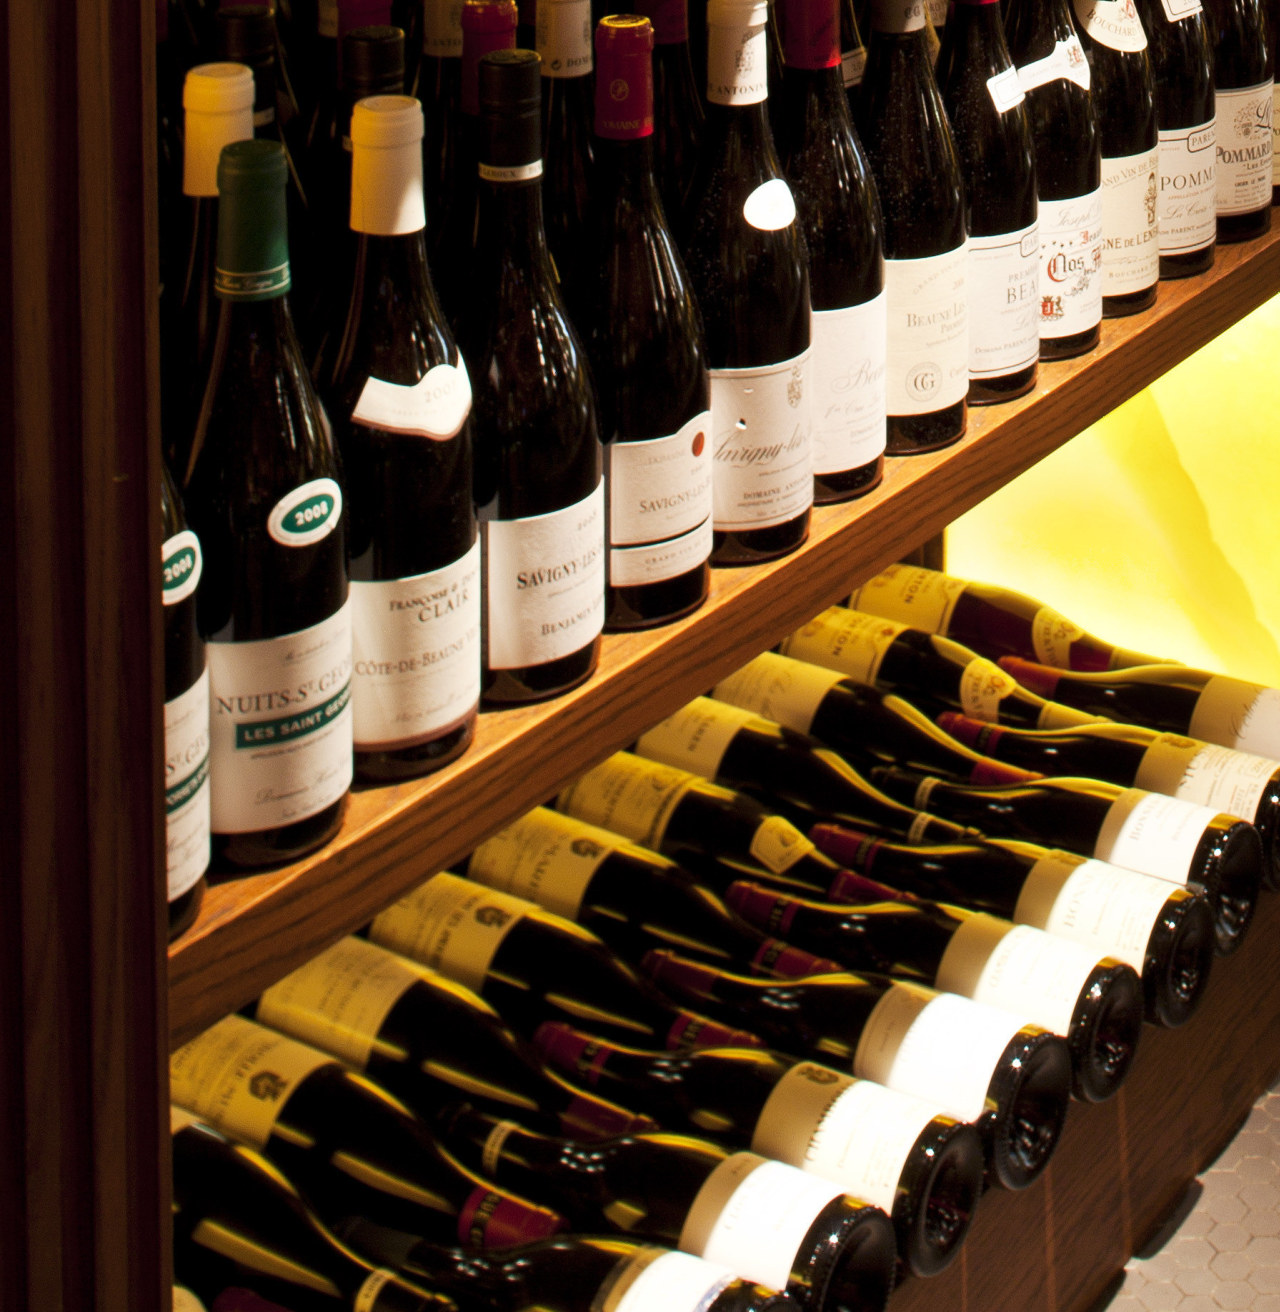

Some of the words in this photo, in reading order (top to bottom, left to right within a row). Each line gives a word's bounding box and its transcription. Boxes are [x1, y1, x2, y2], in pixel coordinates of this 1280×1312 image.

[1047, 251, 1085, 284] Clos
[905, 309, 950, 328] BEAUNE
[295, 499, 328, 526] 2008
[418, 588, 470, 623] CLAIR
[244, 725, 275, 742] LES
[280, 710, 323, 736] SAINT
